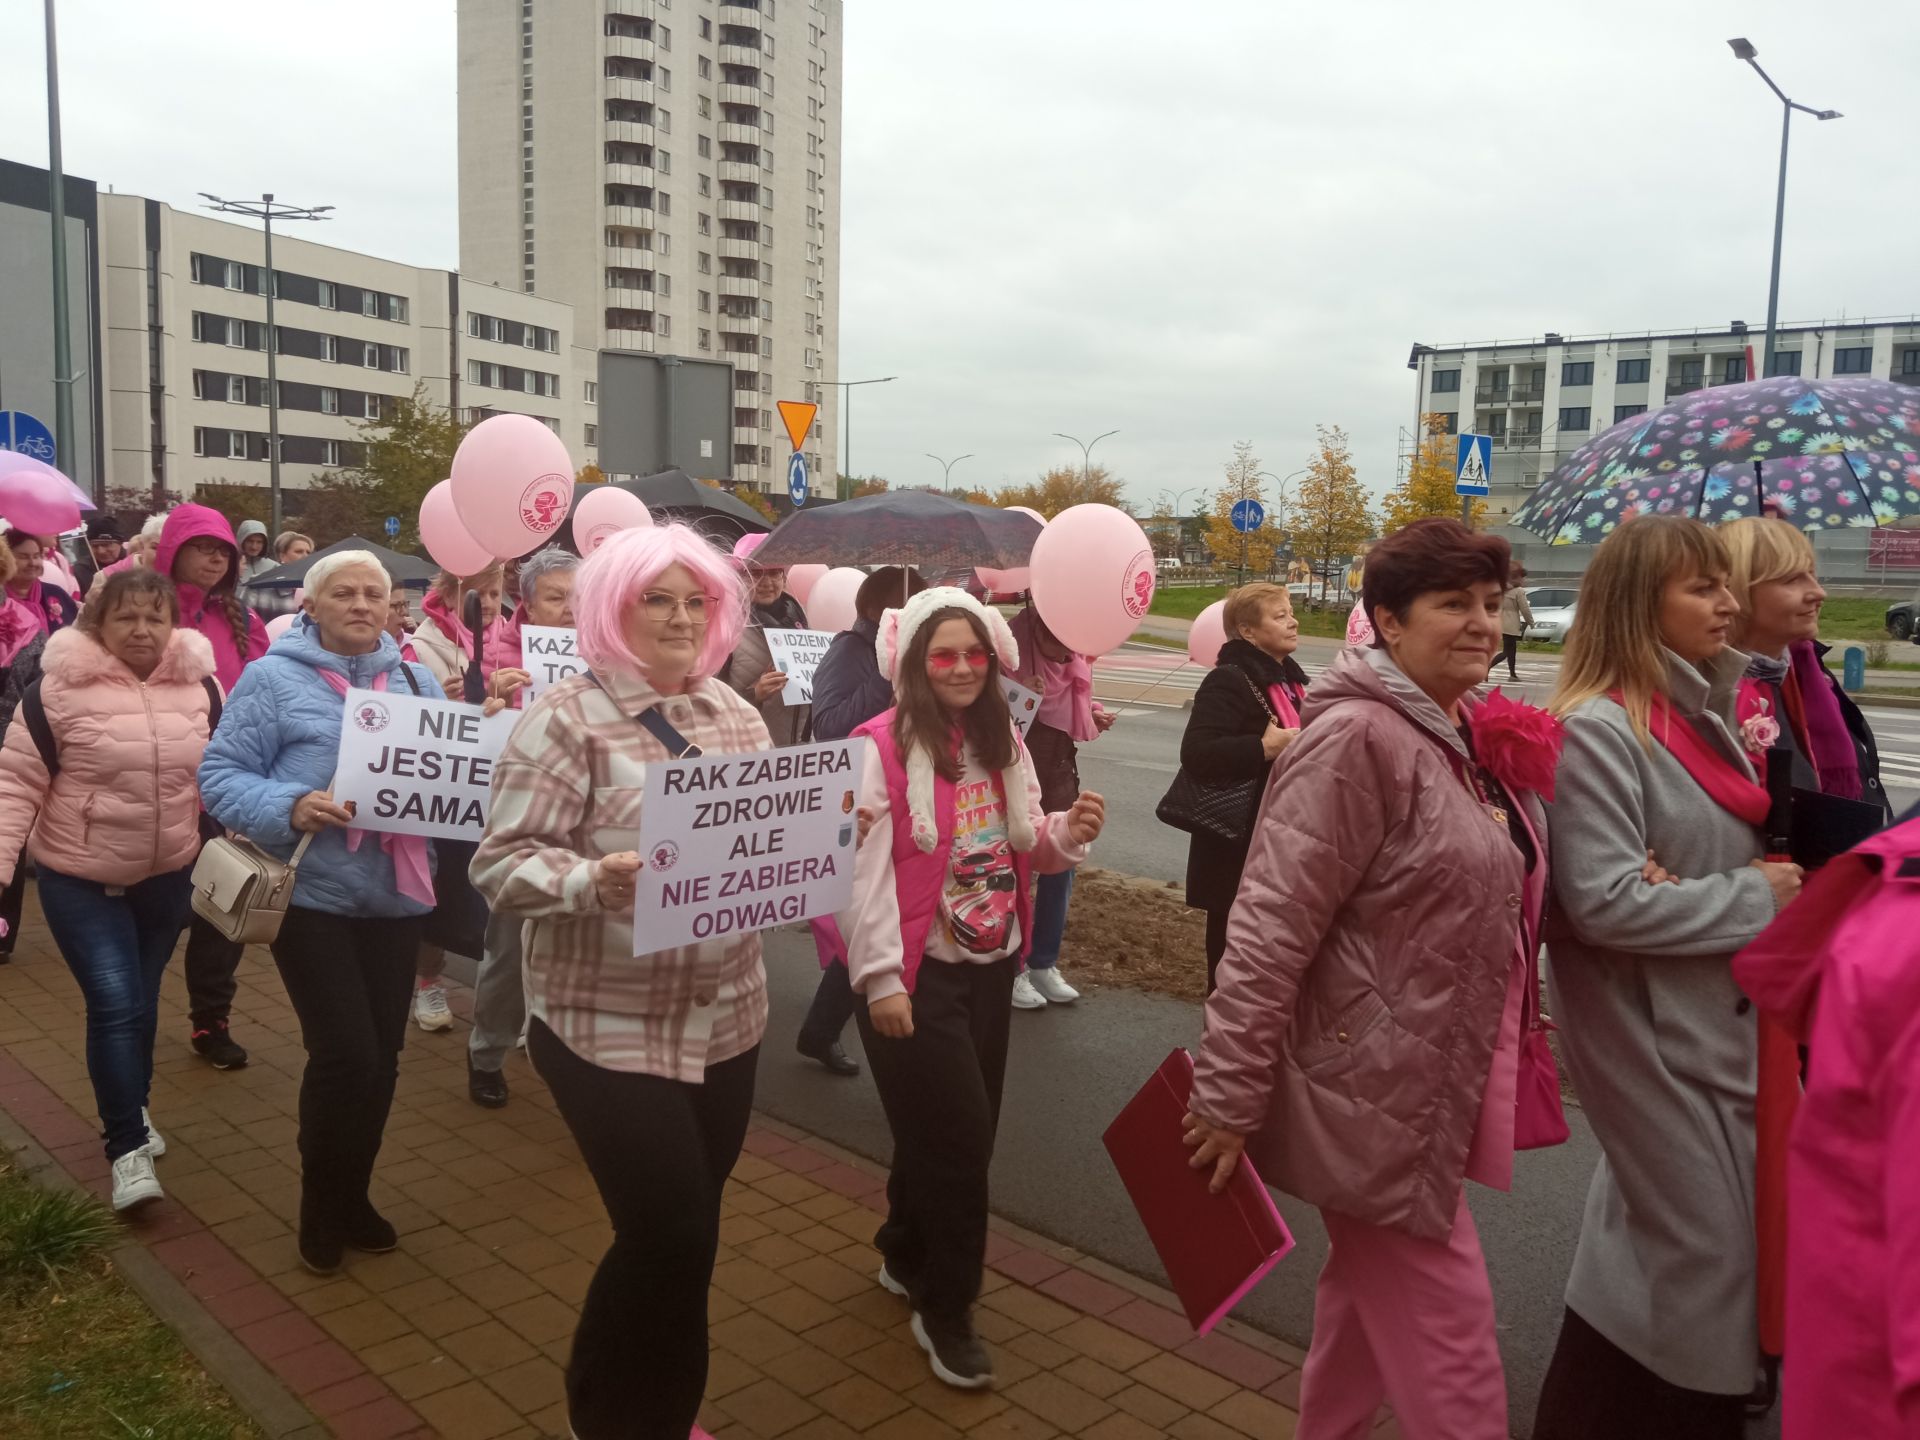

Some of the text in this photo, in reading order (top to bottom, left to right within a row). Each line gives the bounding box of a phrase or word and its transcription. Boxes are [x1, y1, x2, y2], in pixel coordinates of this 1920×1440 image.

[1125, 596, 1145, 616] AMAZ
[527, 635, 575, 657] KAŻ
[783, 633, 832, 648] IDZIEMY
[792, 651, 825, 665] RAZE
[418, 708, 481, 744] NIE
[367, 745, 492, 787] JESTE
[664, 748, 852, 796] RAK ZABIERA
[373, 788, 485, 828] SAMA
[692, 786, 823, 830] ZDROWIE
[728, 828, 785, 861] ALE
[661, 854, 837, 909] NIE ZABIERA
[692, 893, 807, 939] ODWAGI
